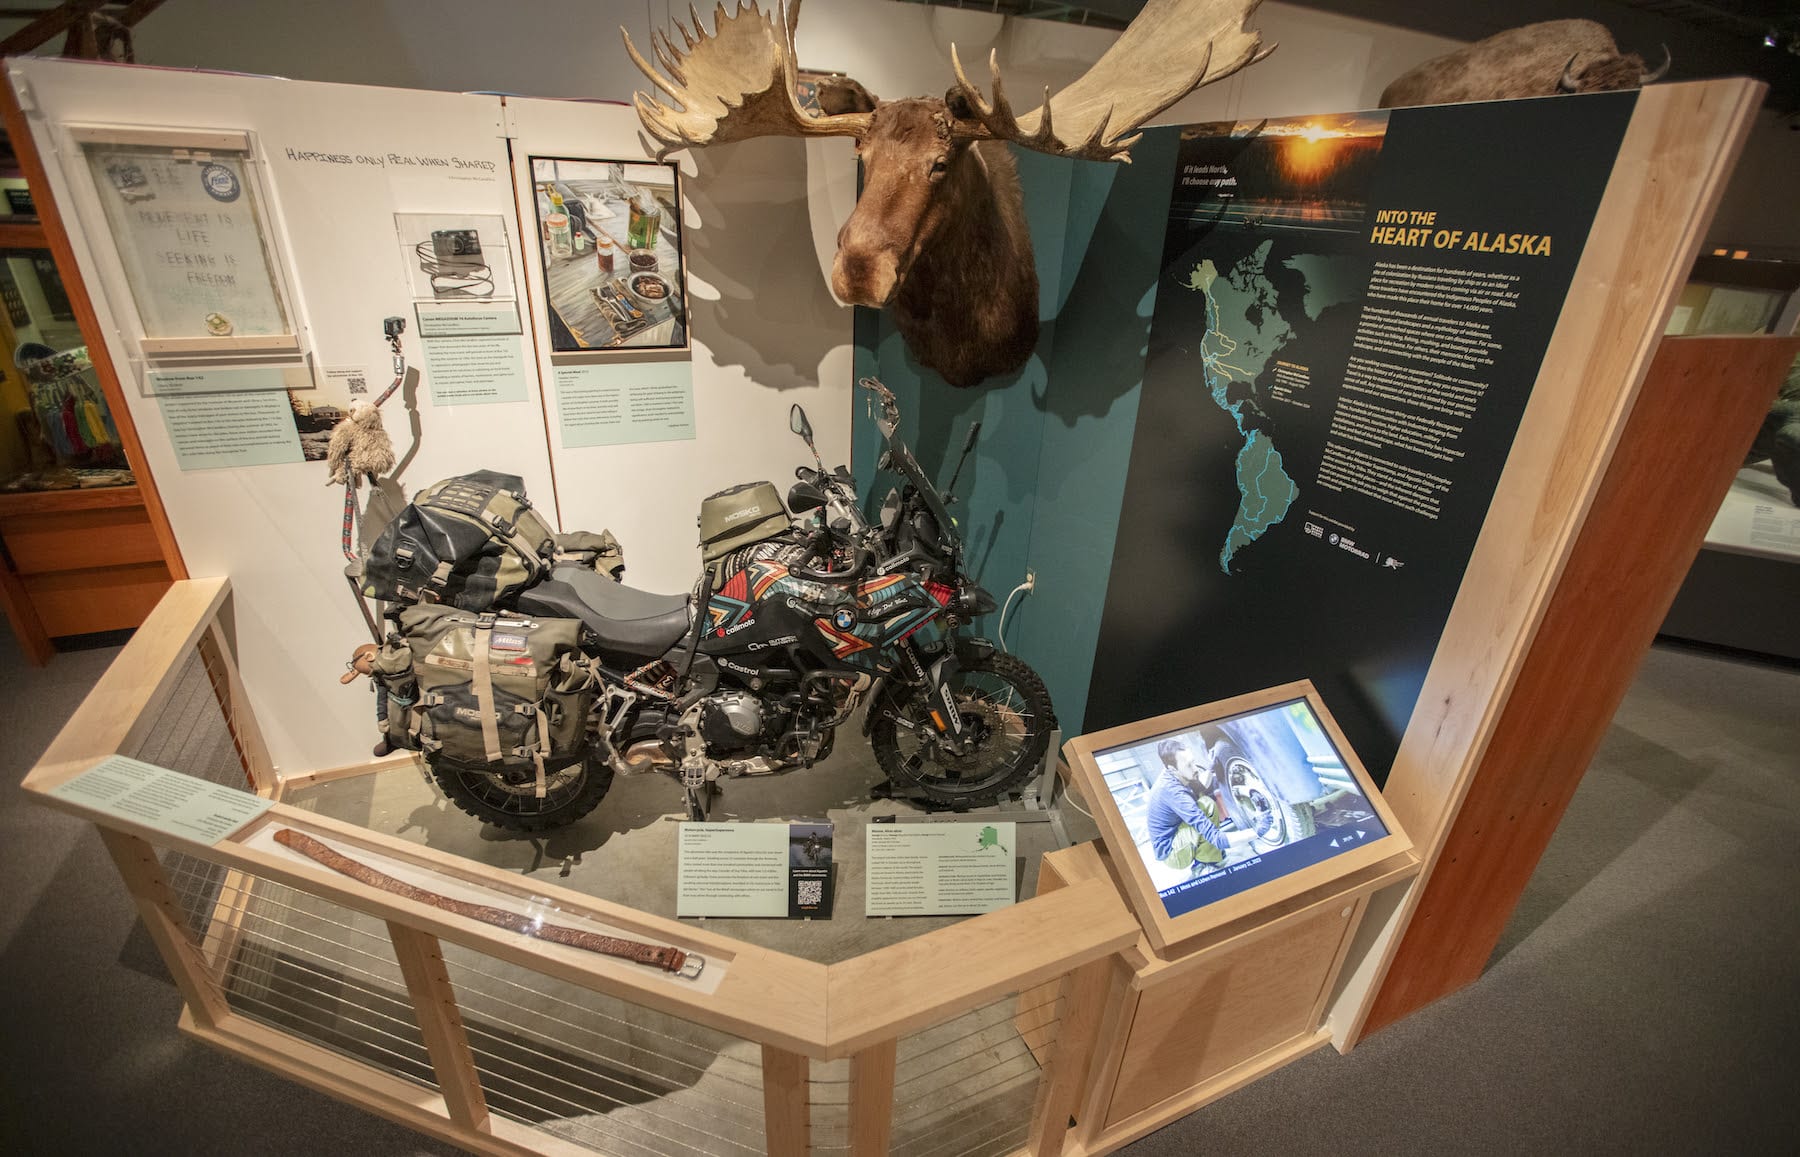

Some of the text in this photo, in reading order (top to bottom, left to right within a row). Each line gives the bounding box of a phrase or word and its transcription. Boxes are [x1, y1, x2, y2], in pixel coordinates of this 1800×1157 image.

[285, 147, 353, 164] HAPPINESS
[355, 155, 385, 169] ONLY
[418, 156, 450, 167] WHEN
[1376, 209, 1437, 226] INTO THE
[1370, 226, 1551, 256] HEART OF ALASKA
[725, 506, 760, 522] MOSKO
[726, 618, 755, 635] calimoto
[728, 661, 760, 676] Castrol
[905, 646, 926, 681] Castrol
[456, 707, 501, 719] MOSO
